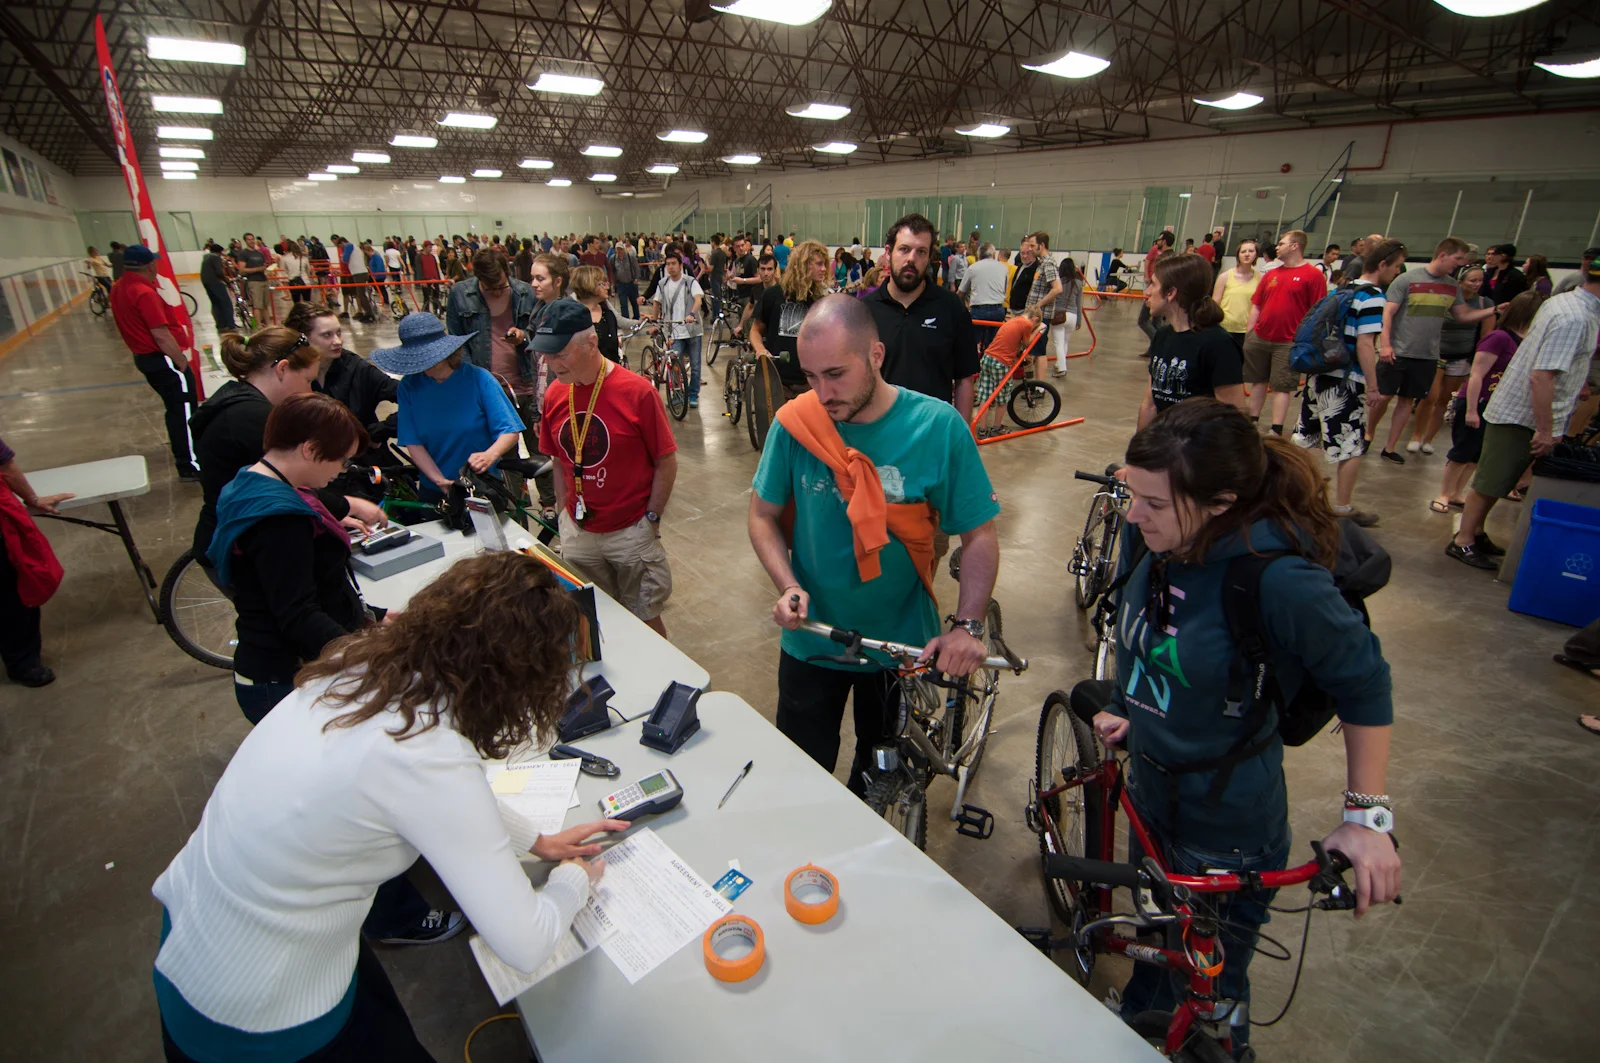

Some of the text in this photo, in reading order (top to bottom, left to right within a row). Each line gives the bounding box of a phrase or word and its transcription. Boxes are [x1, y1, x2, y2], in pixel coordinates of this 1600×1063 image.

[670, 859, 703, 889] AGREEMENT
[702, 889, 712, 898] TO
[711, 898, 727, 912] SELL
[594, 904, 614, 928] RECEIPT
